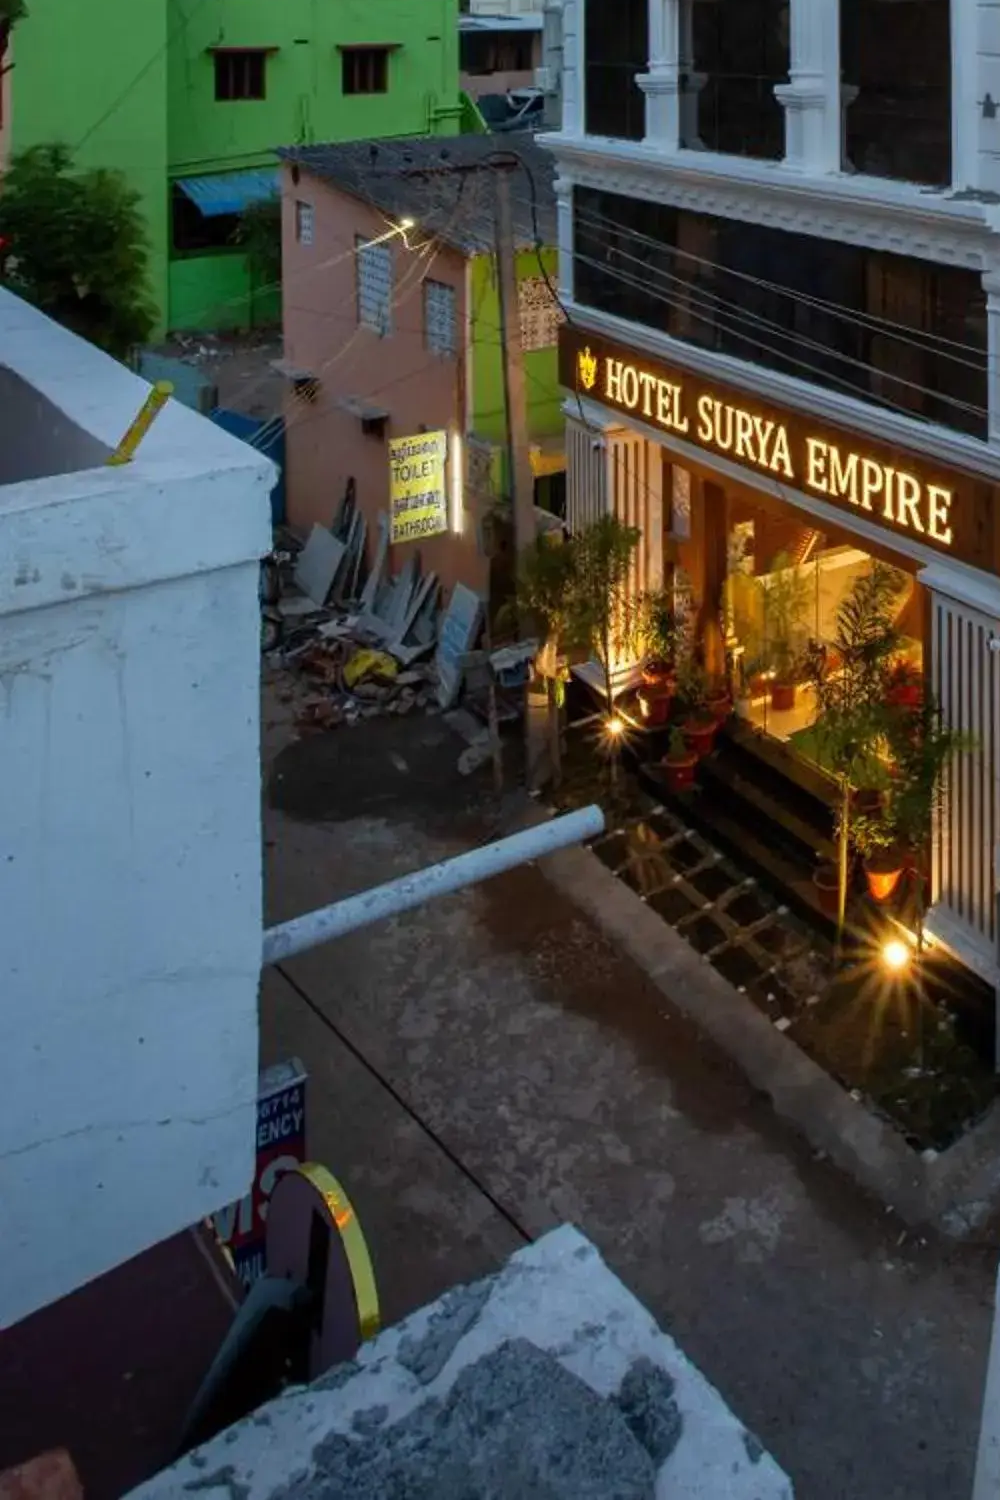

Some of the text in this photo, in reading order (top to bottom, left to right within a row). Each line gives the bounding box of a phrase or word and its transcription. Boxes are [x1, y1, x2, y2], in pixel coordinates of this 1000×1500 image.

[393, 459, 437, 483] TOILET
[604, 357, 689, 433] HOTEL
[697, 395, 795, 479] SURYA
[805, 436, 955, 546] EMPIRE
